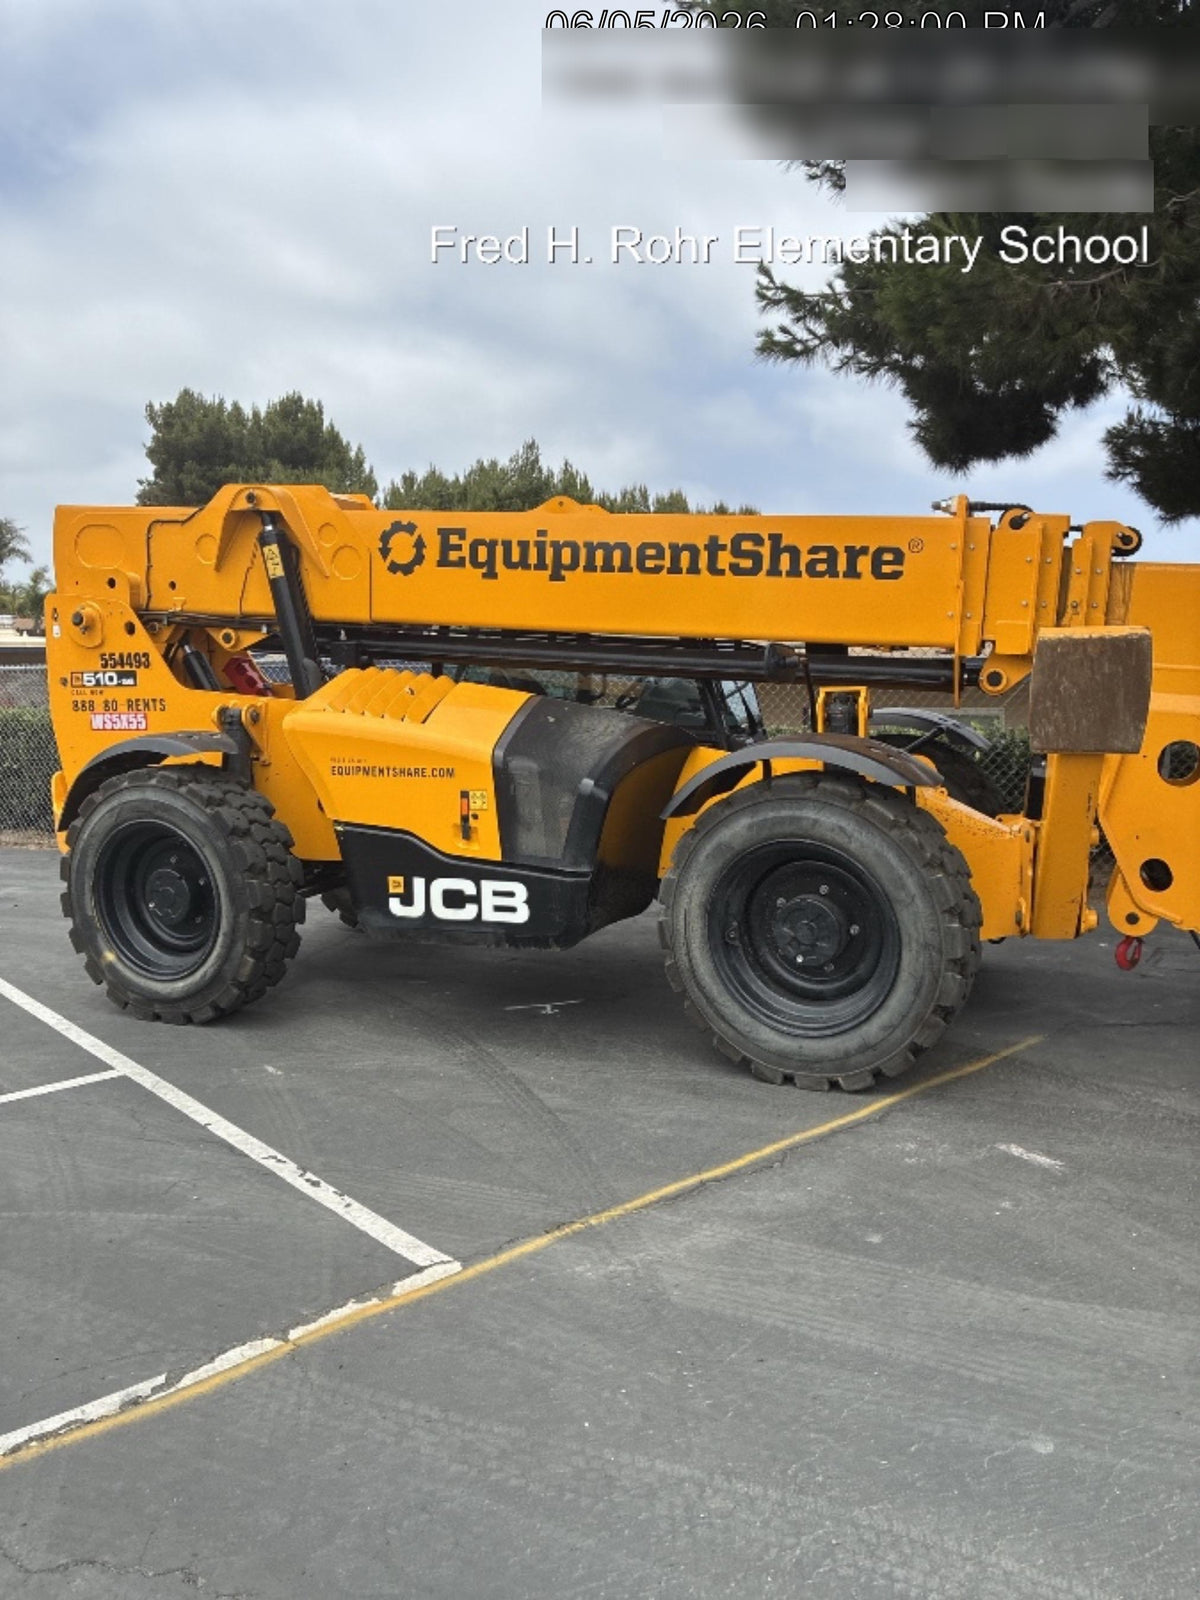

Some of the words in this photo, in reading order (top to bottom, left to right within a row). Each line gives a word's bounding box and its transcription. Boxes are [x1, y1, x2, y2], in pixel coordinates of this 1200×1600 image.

[100, 653, 151, 670] 554493
[91, 713, 147, 730] WS5X55
[331, 765, 455, 778] EQUIPMENTSHARE.COM
[388, 876, 531, 924] JCB
